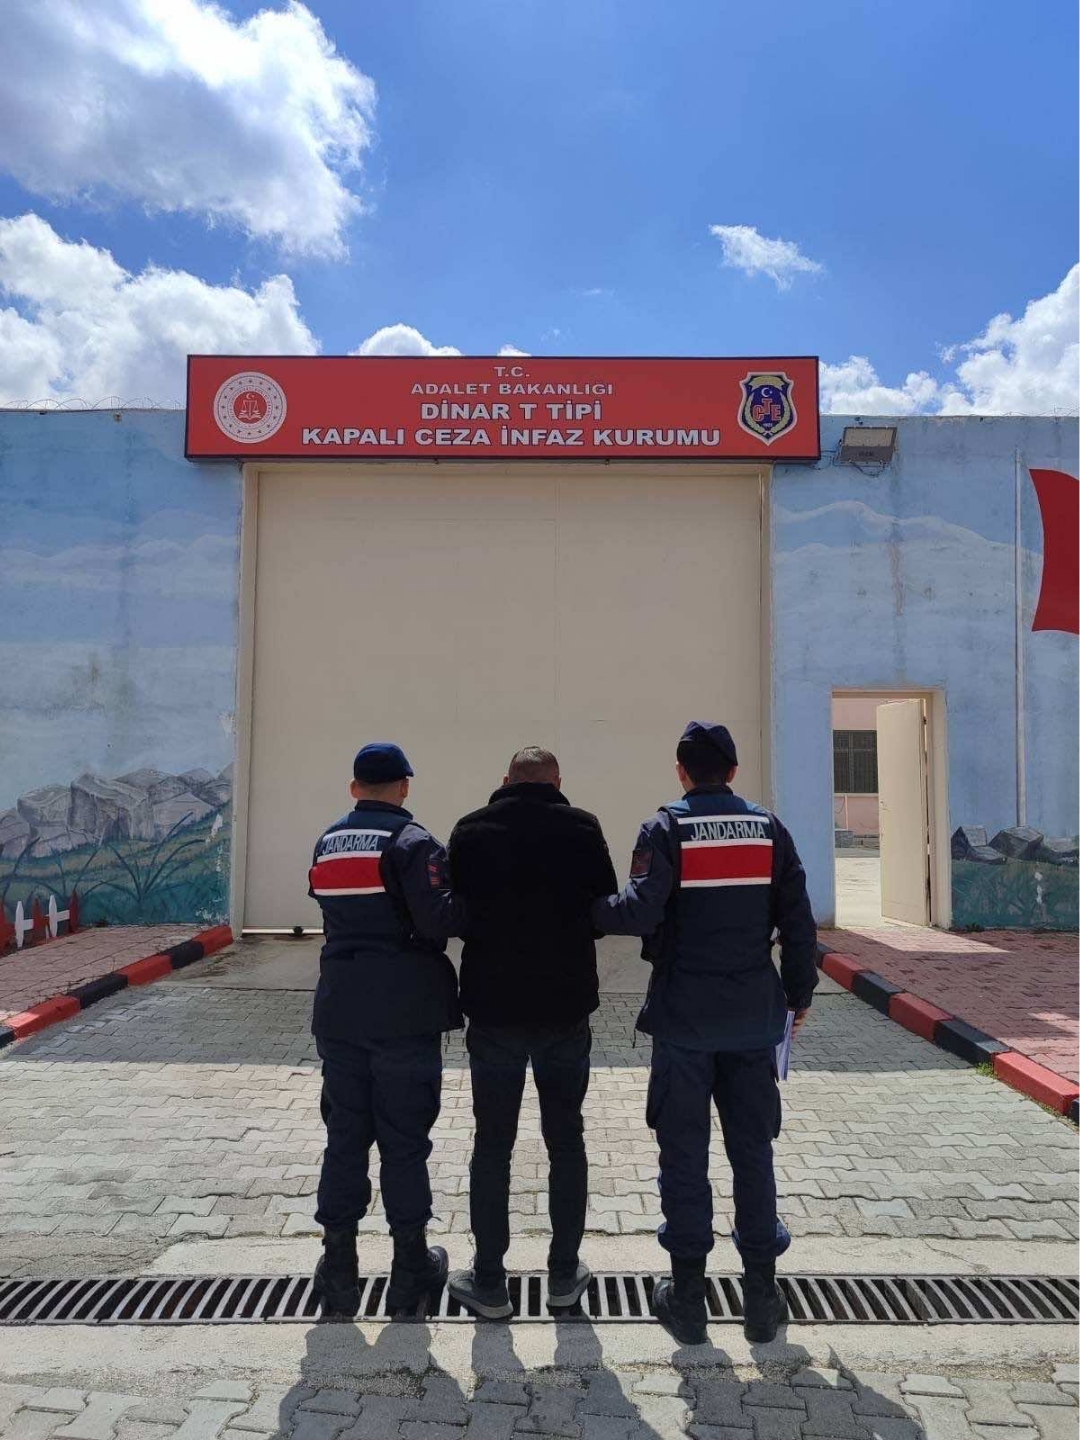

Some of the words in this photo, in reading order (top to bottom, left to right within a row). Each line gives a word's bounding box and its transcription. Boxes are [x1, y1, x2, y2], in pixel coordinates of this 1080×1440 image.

[494, 366, 530, 377] T.C.
[411, 383, 491, 395] ADALET
[421, 400, 510, 419] DİNAR
[519, 403, 538, 419] T
[546, 400, 602, 419] TİPİ
[302, 428, 404, 445] KAPALI
[415, 428, 491, 445] CEZA
[501, 426, 584, 445] İNFAZ
[594, 429, 720, 445] KURUMU
[691, 821, 766, 840] JANDARMA
[322, 834, 380, 855] JANDARMA
